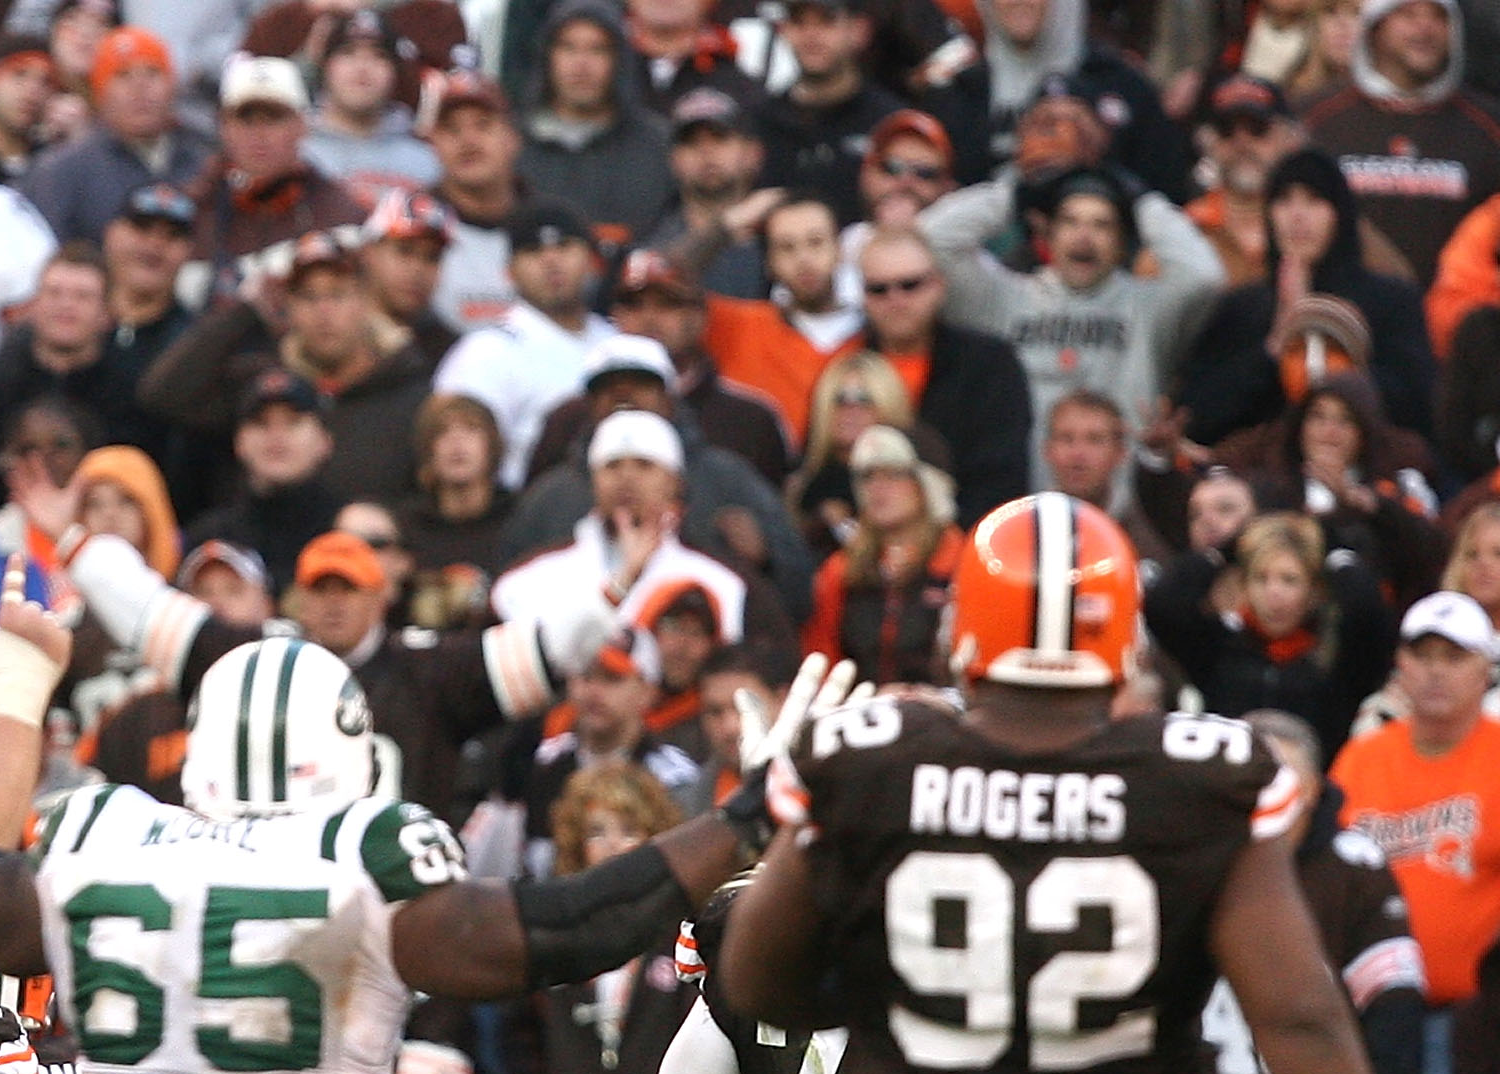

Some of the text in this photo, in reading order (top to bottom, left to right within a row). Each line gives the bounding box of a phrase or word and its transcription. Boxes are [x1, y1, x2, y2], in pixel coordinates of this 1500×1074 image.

[910, 764, 1128, 843] ROGERS
[64, 883, 330, 1072] 65
[885, 852, 1161, 1072] 92
